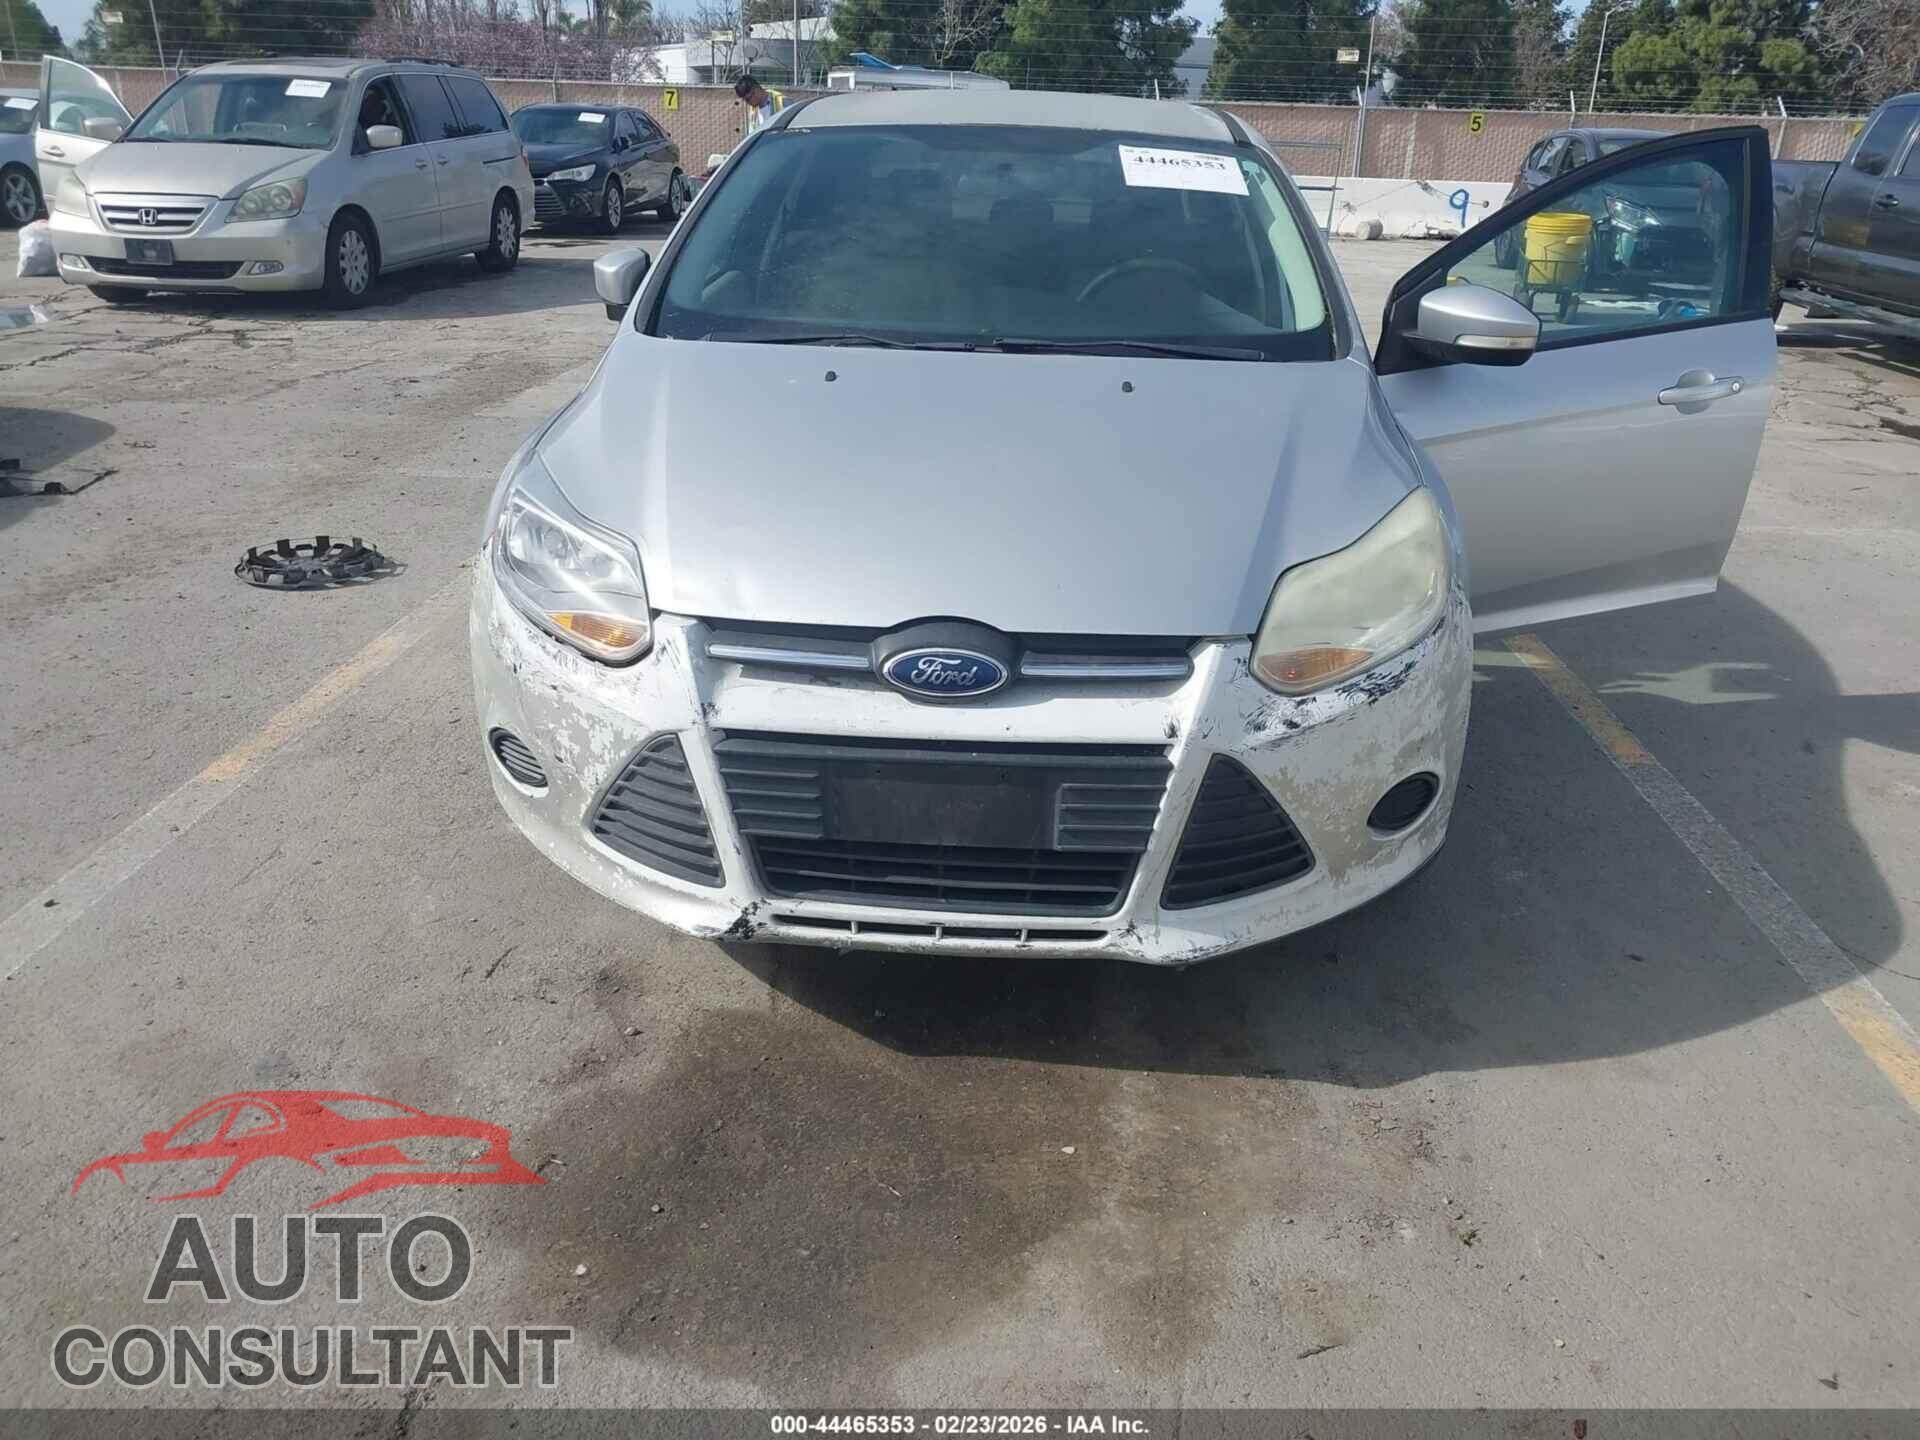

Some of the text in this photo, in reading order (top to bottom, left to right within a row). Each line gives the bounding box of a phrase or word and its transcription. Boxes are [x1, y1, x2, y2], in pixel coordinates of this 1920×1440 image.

[666, 91, 675, 106] 7
[1471, 116, 1482, 132] 5
[1133, 155, 1226, 170] 44465353
[1449, 188, 1469, 228] 9
[911, 656, 978, 686] Ford
